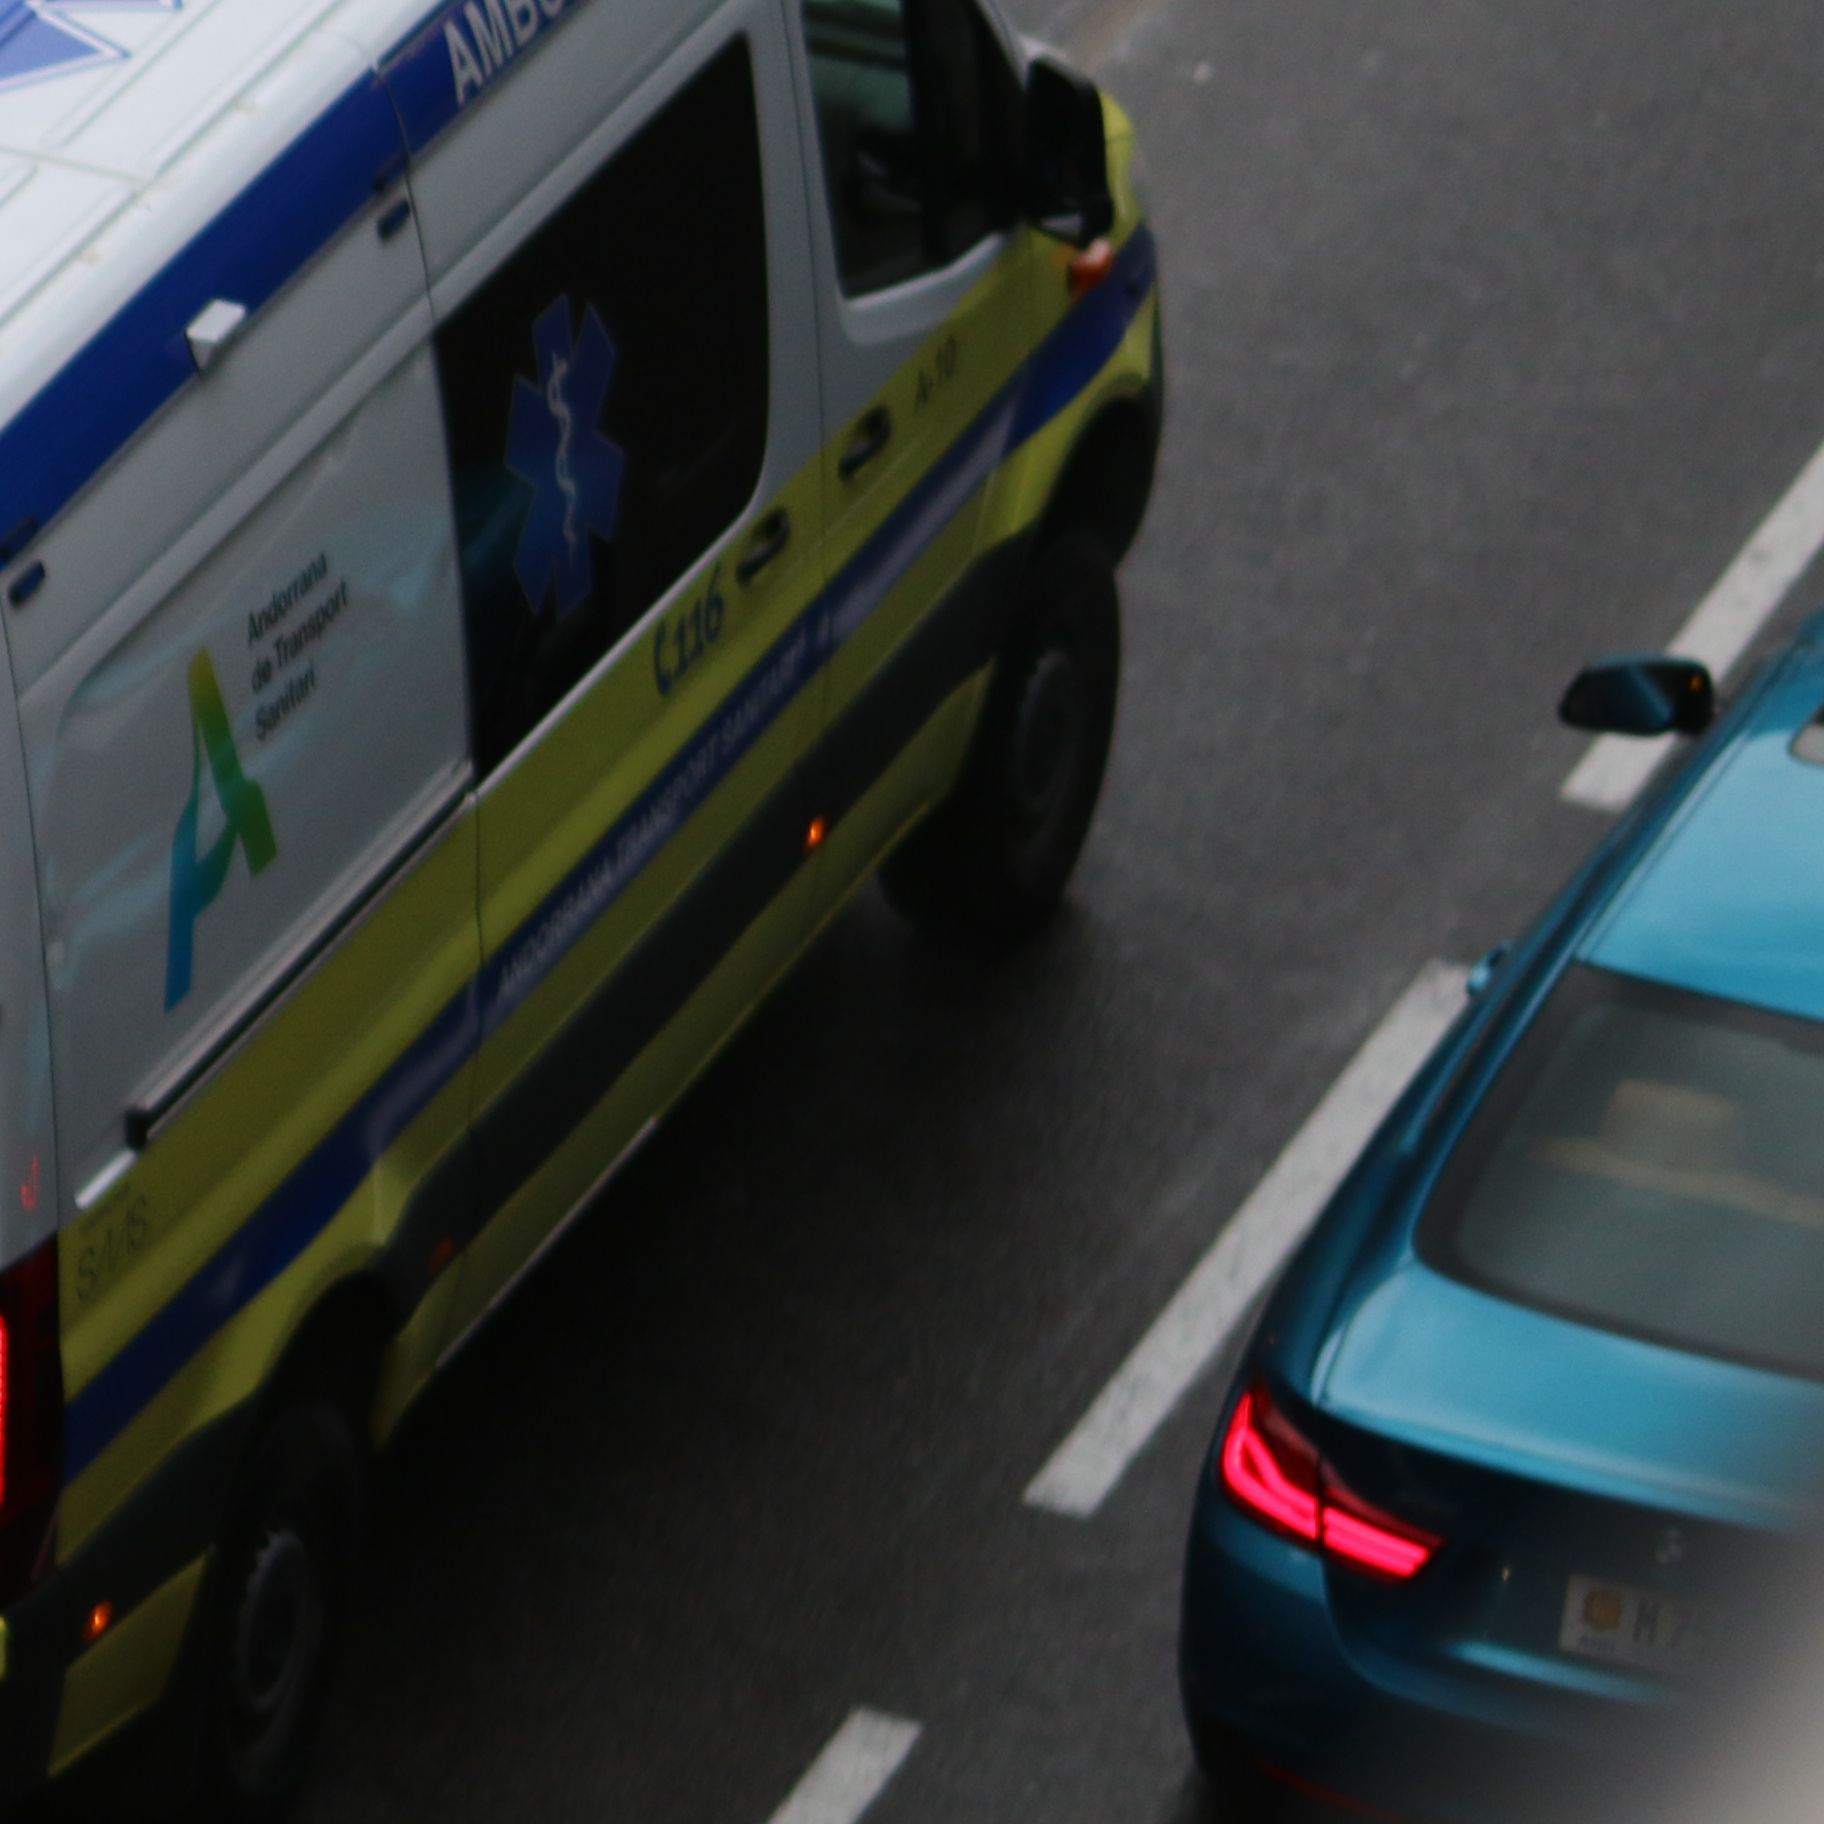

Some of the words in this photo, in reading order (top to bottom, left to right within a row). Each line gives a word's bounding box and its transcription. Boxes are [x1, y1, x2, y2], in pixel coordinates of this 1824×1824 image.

[248, 552, 328, 647] Andorrana
[253, 657, 273, 694] de
[274, 578, 348, 668] Transport
[673, 562, 724, 678] 116
[255, 660, 316, 741] Sanitari
